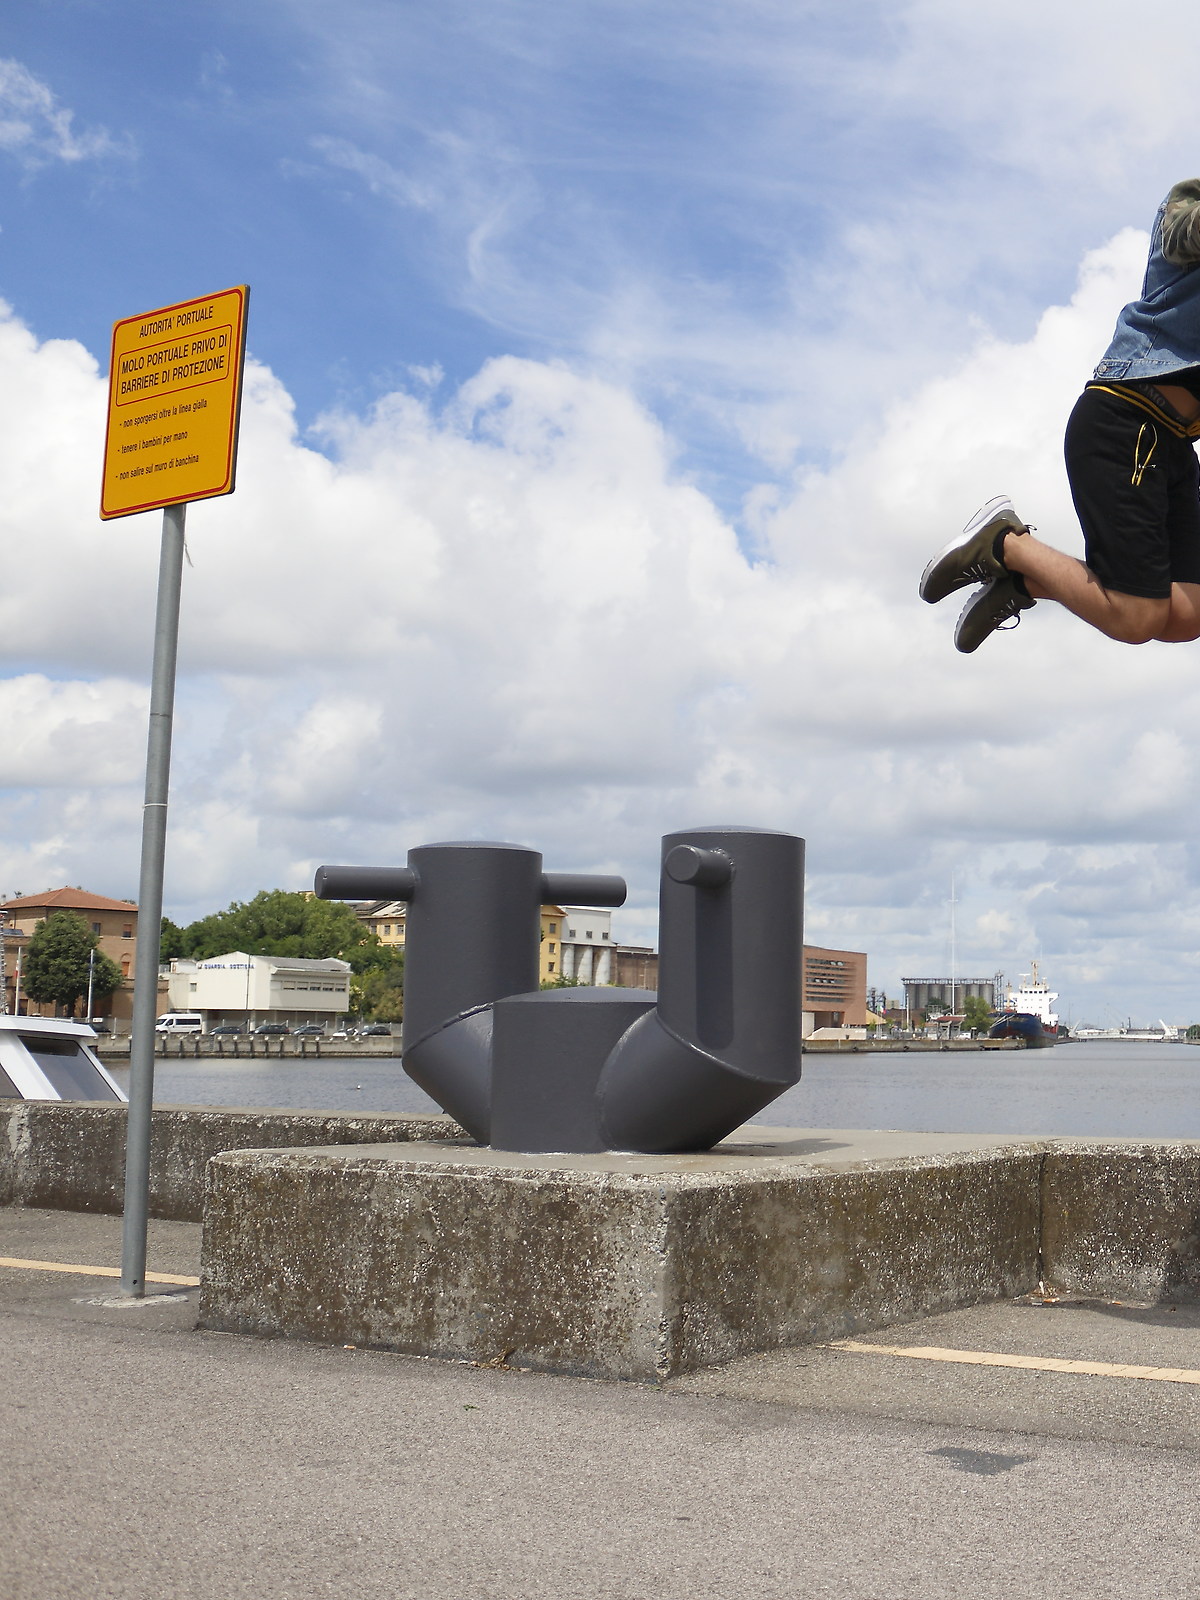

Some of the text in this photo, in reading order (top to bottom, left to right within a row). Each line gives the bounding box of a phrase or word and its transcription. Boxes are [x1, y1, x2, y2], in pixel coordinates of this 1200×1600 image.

[139, 306, 214, 338] AUTORITA' PORTUALE
[122, 334, 227, 374] MOLO PORTUALE PRIVO DI
[121, 355, 225, 394] BARRIERE DI PROTEZIONE
[123, 418, 133, 428] non
[134, 410, 159, 426] sporgersi
[158, 408, 171, 419] oltre
[172, 406, 178, 415] la
[178, 403, 191, 414] linea
[192, 398, 208, 413] gialla
[121, 443, 138, 454] tenere
[142, 435, 162, 449] bambini
[163, 434, 173, 445] per
[173, 431, 188, 441] mano
[119, 471, 130, 480] non
[130, 466, 145, 477] salire
[145, 463, 154, 474] sul
[154, 461, 168, 472] muro
[168, 458, 175, 469] di
[175, 453, 199, 467] banchina
